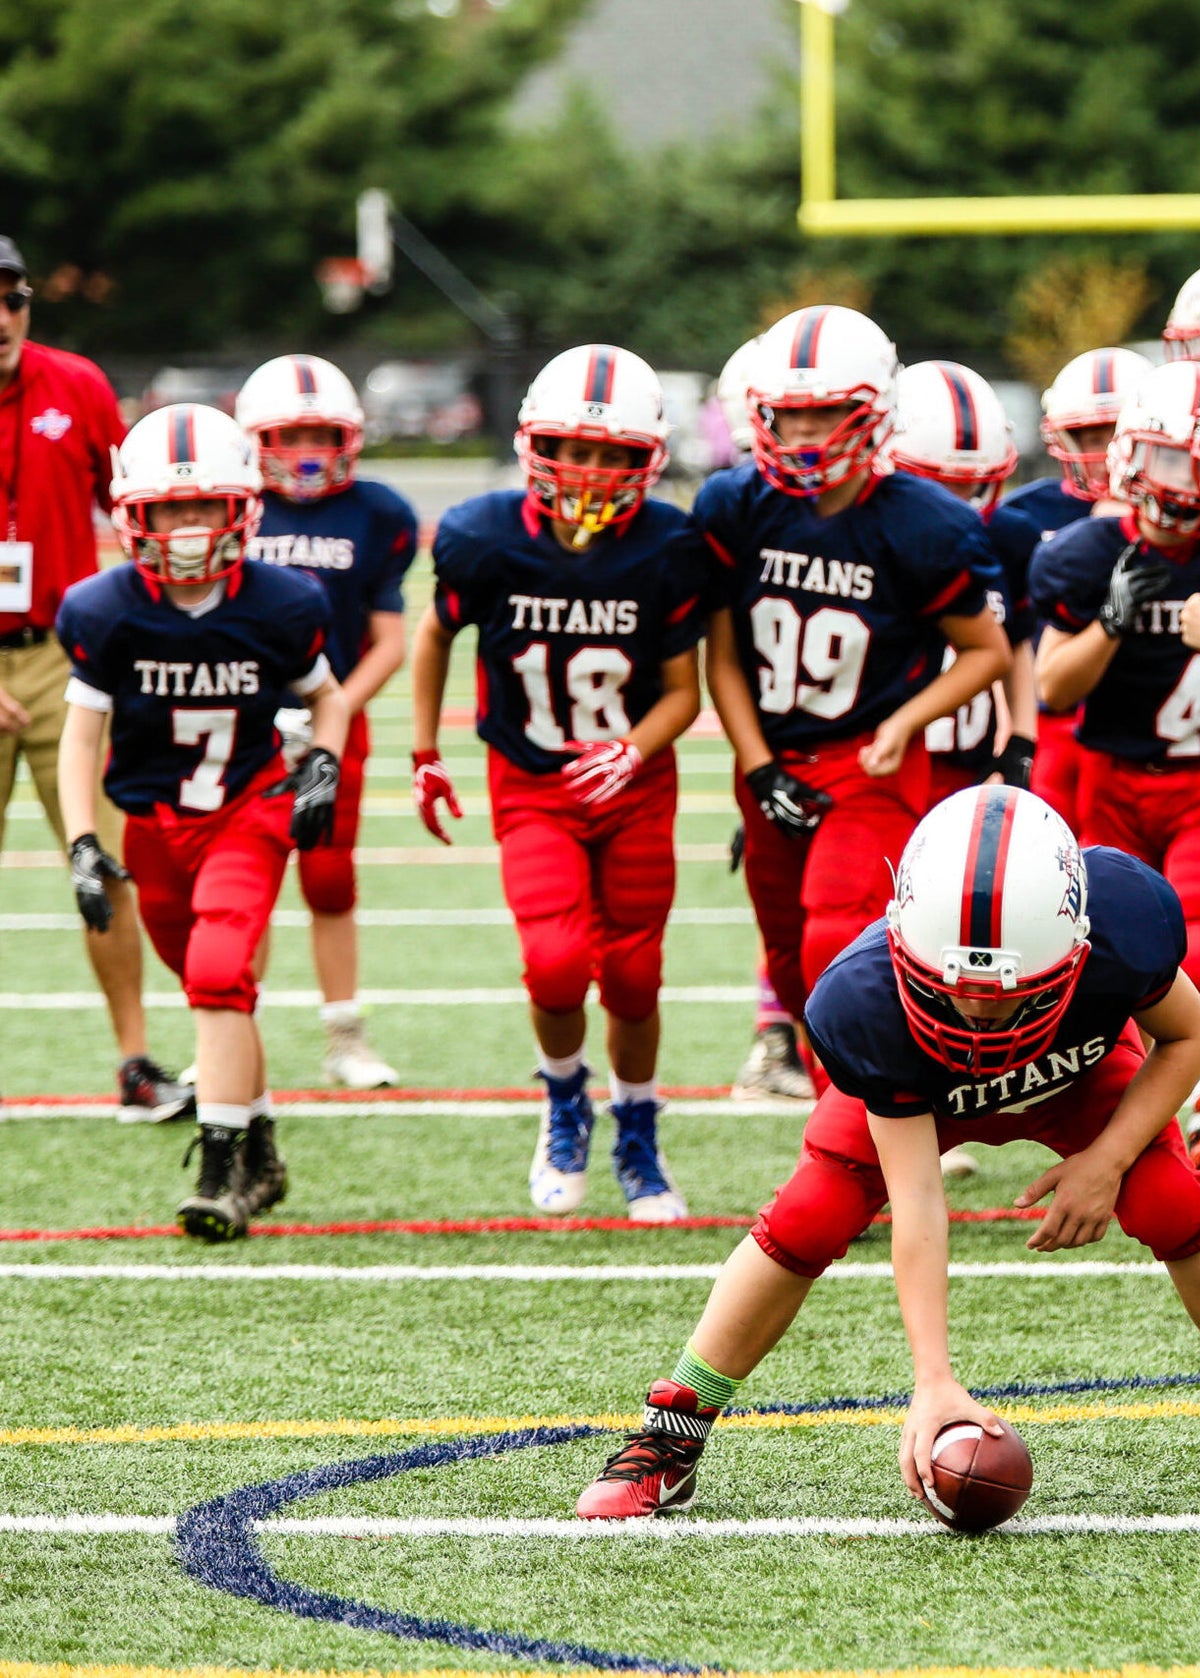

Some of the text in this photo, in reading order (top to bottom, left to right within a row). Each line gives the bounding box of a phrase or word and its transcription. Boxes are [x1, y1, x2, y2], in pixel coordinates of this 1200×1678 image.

[246, 535, 355, 570] TITANS
[759, 547, 875, 601] TITANS
[508, 594, 640, 636] TITANS
[133, 659, 260, 697] TITANS
[750, 595, 873, 721] 99
[511, 641, 634, 752] 18
[171, 707, 239, 813] 7
[948, 1036, 1106, 1115] TITANS
